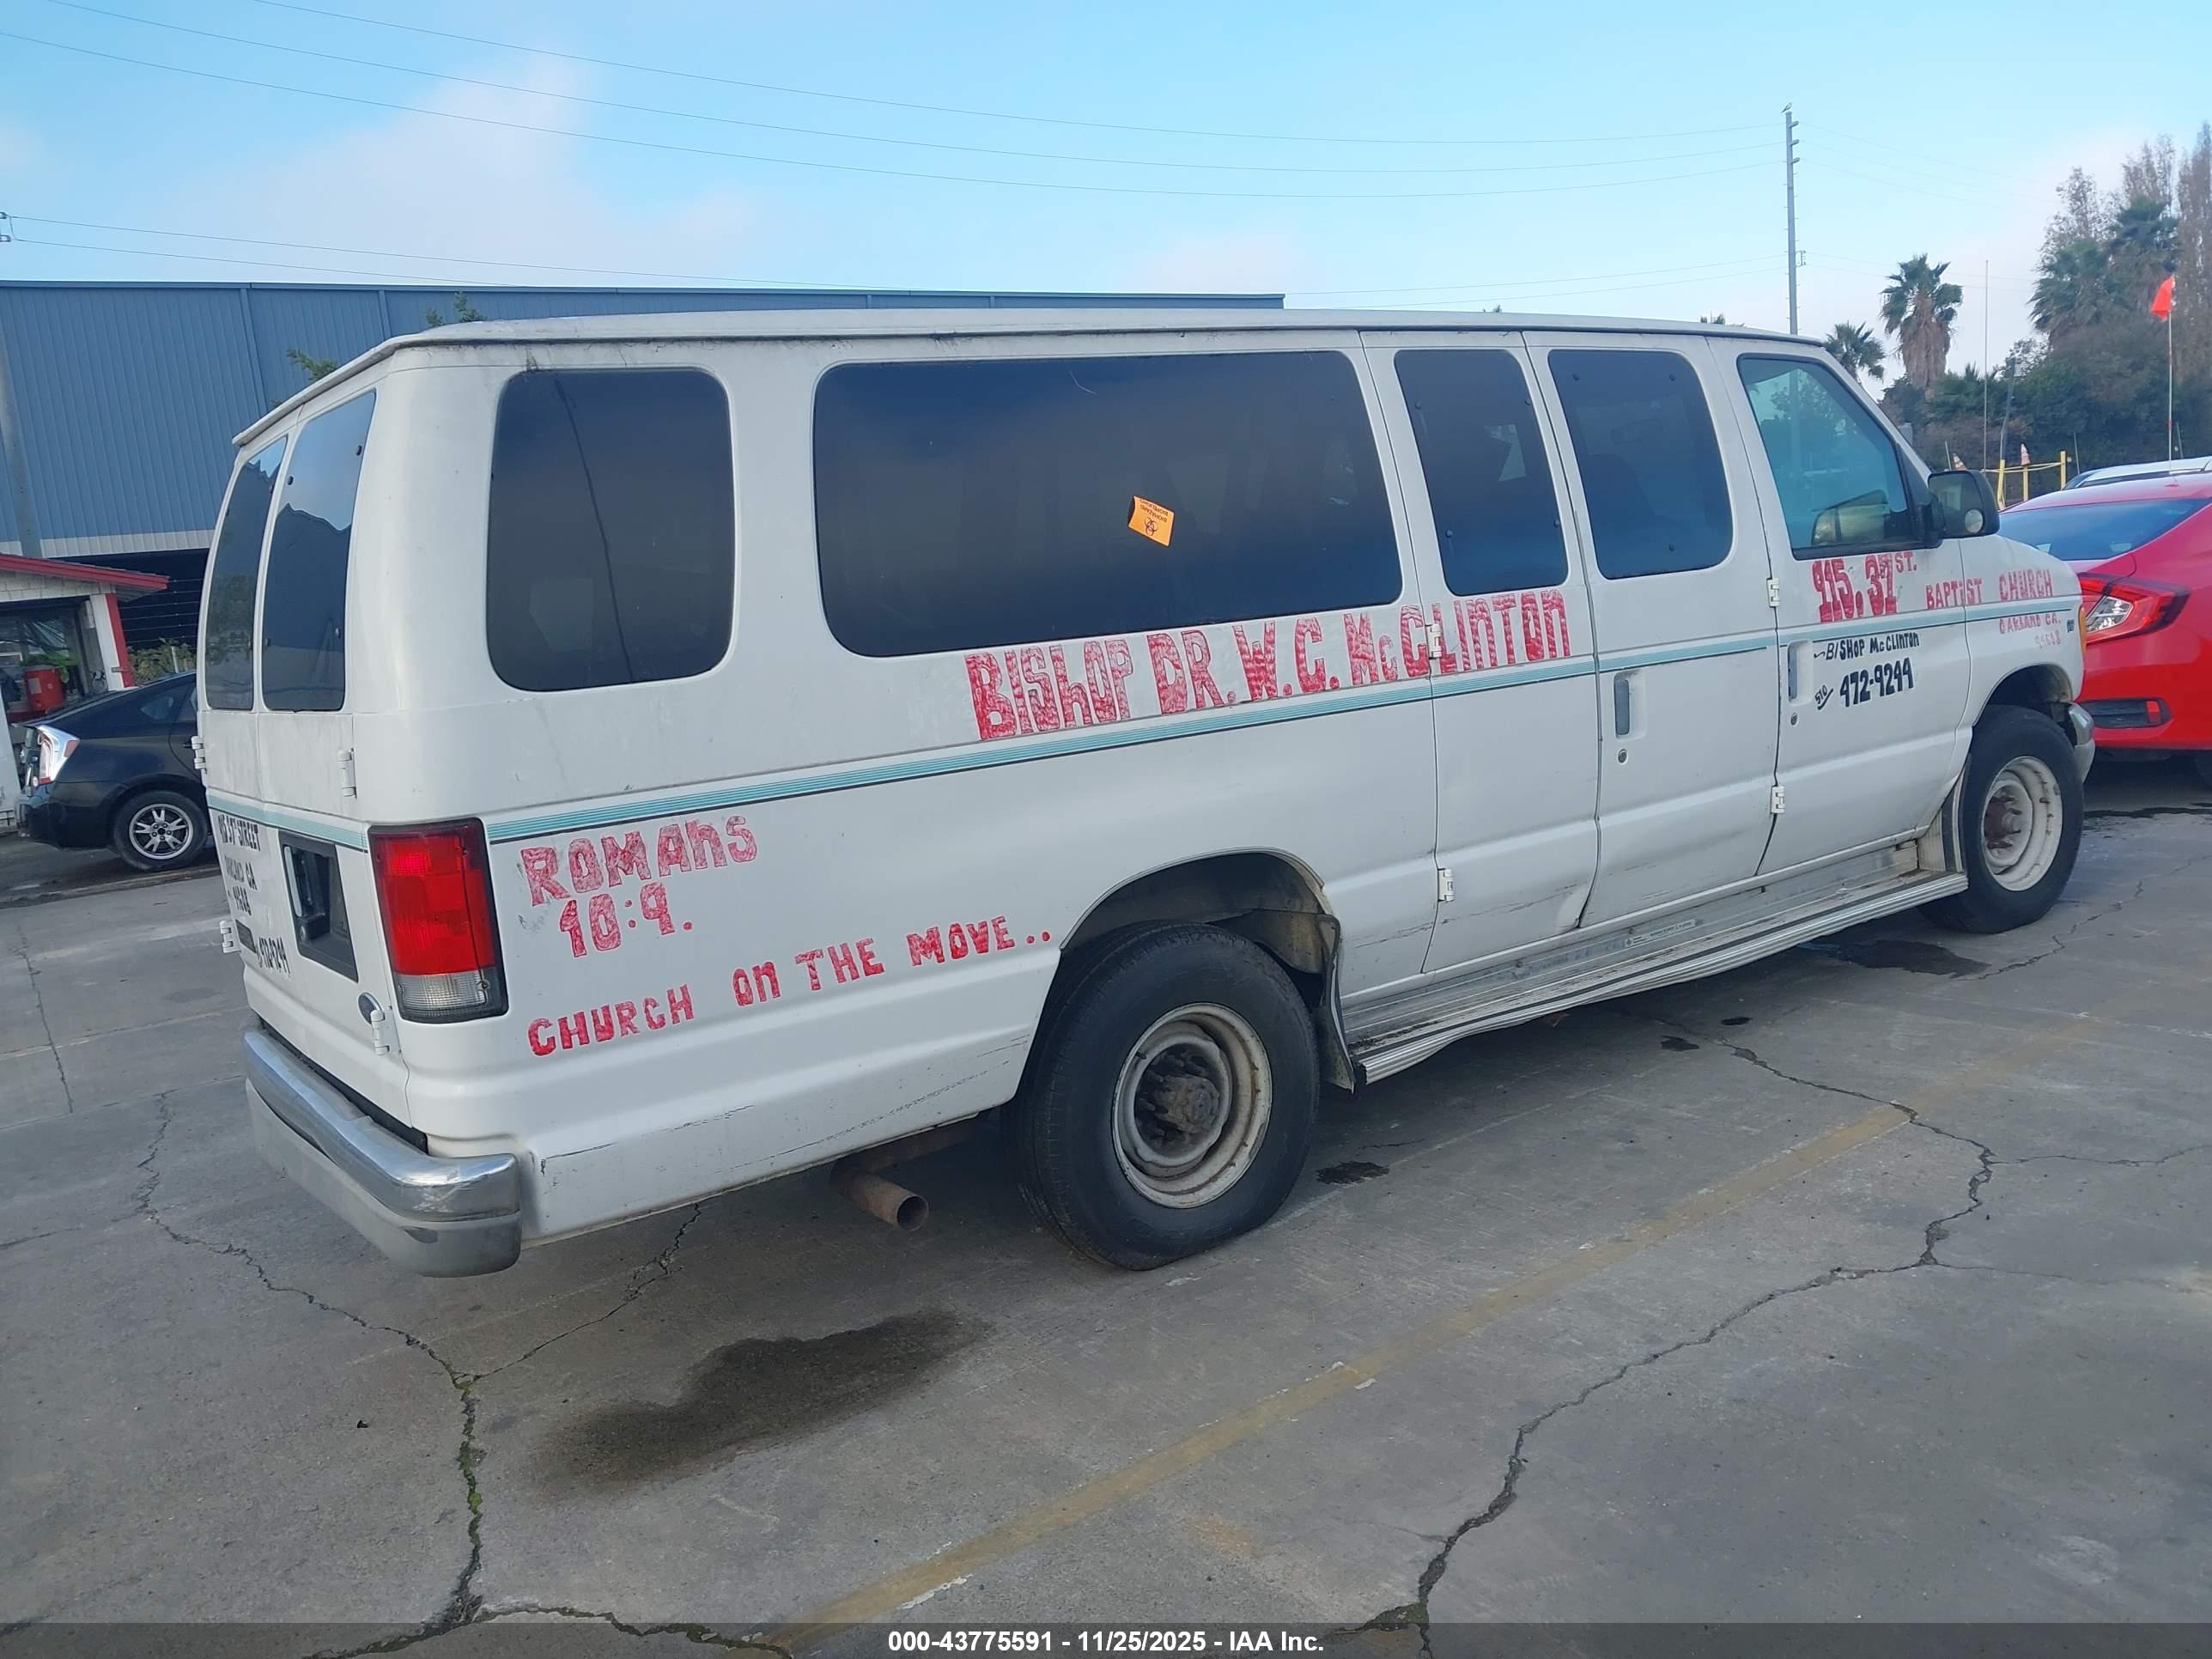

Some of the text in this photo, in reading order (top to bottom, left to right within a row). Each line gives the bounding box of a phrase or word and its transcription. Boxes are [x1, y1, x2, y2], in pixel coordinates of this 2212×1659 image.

[1999, 568, 2053, 601] CHURCH
[1147, 628, 1237, 716] DR.
[1826, 639, 1865, 660] BISHOP
[1839, 657, 1914, 708] 472-9244
[559, 882, 694, 958] 10:9.
[526, 983, 696, 1057] CHURCH
[795, 937, 885, 992] THE
